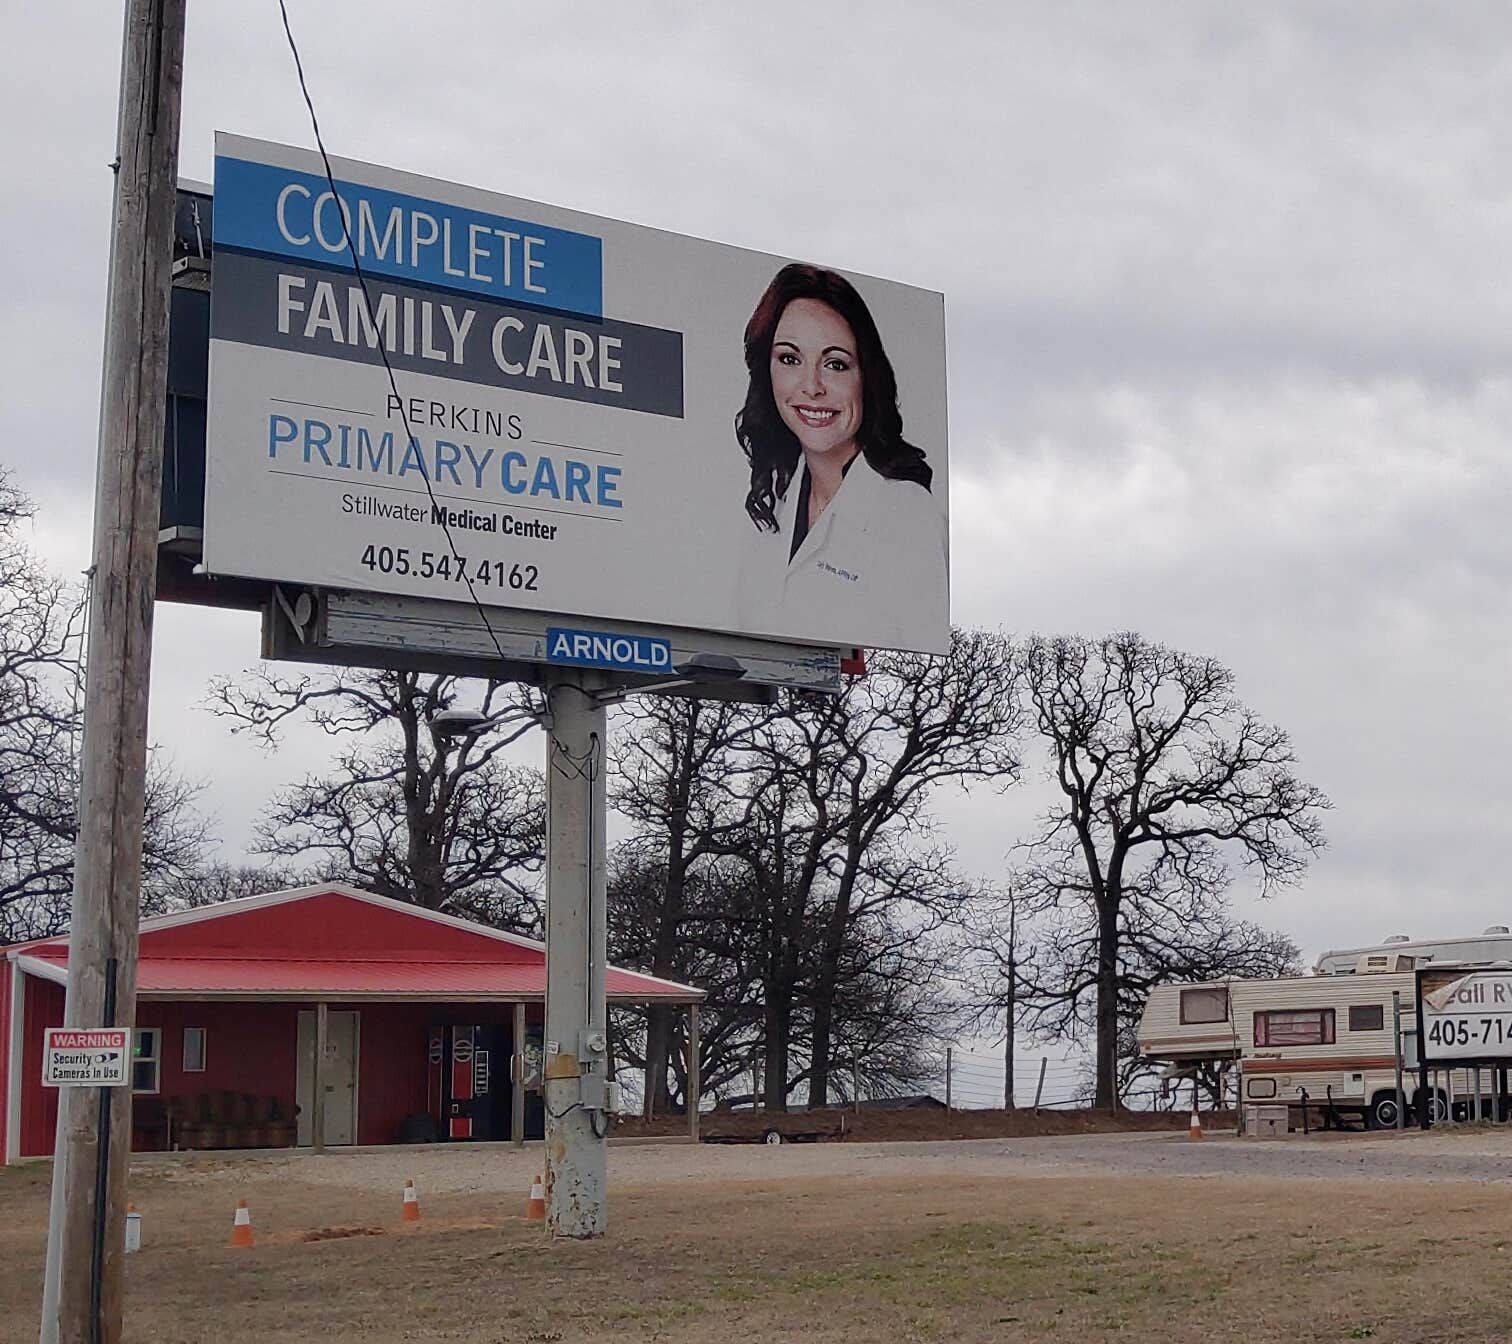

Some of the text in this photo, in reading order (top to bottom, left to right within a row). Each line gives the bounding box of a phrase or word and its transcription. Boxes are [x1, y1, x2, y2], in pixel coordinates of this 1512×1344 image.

[276, 184, 547, 294] COMPLETE
[278, 273, 623, 393] FAMILY CARE
[386, 394, 523, 440] PERKINS
[341, 494, 558, 540] Stillwater Medical Center
[361, 544, 539, 591] 405.547.4162
[551, 633, 669, 666] ARNOLD
[53, 1034, 122, 1047] WARNING
[53, 1052, 92, 1068] Security
[52, 1067, 91, 1079] Cameras
[103, 1066, 119, 1078] Use
